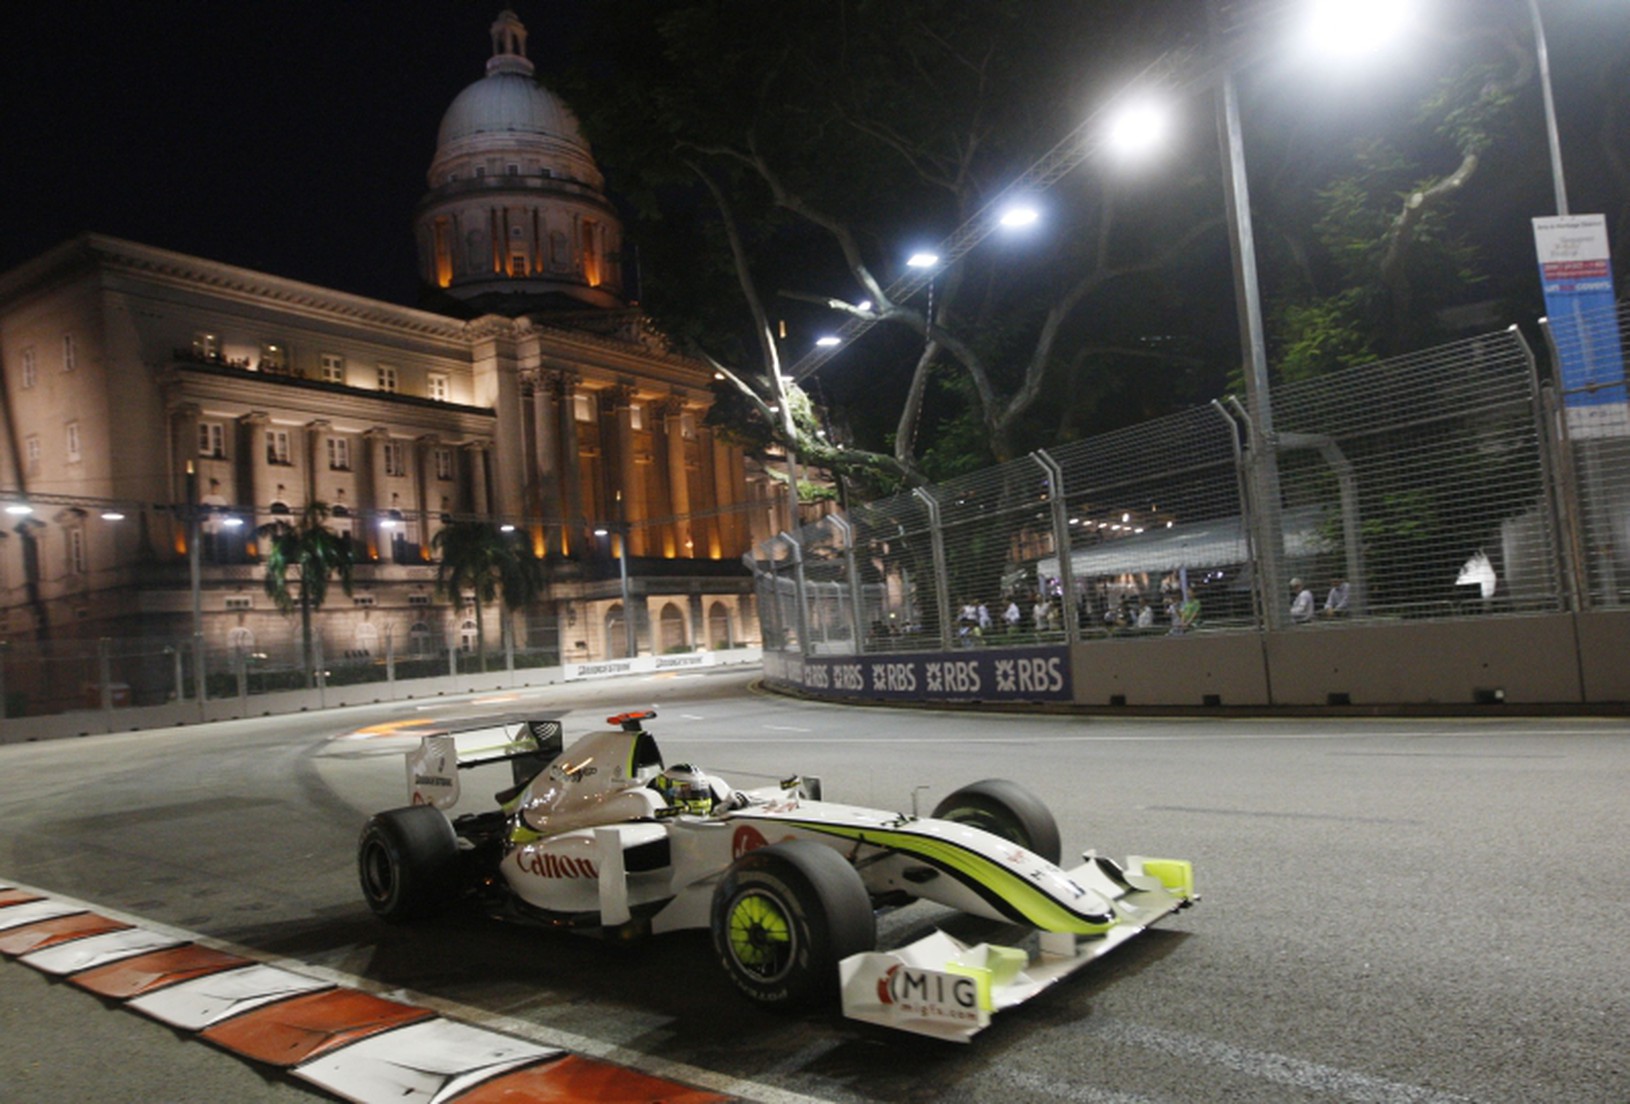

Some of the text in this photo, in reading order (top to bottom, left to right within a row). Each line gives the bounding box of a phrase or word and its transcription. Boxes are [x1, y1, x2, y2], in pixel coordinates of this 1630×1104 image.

[842, 664, 864, 690] RBS
[887, 663, 916, 691] RBS
[943, 661, 981, 692] RBS
[1019, 657, 1063, 692] RBS
[516, 850, 599, 879] Canon
[902, 970, 975, 1008] MIG
